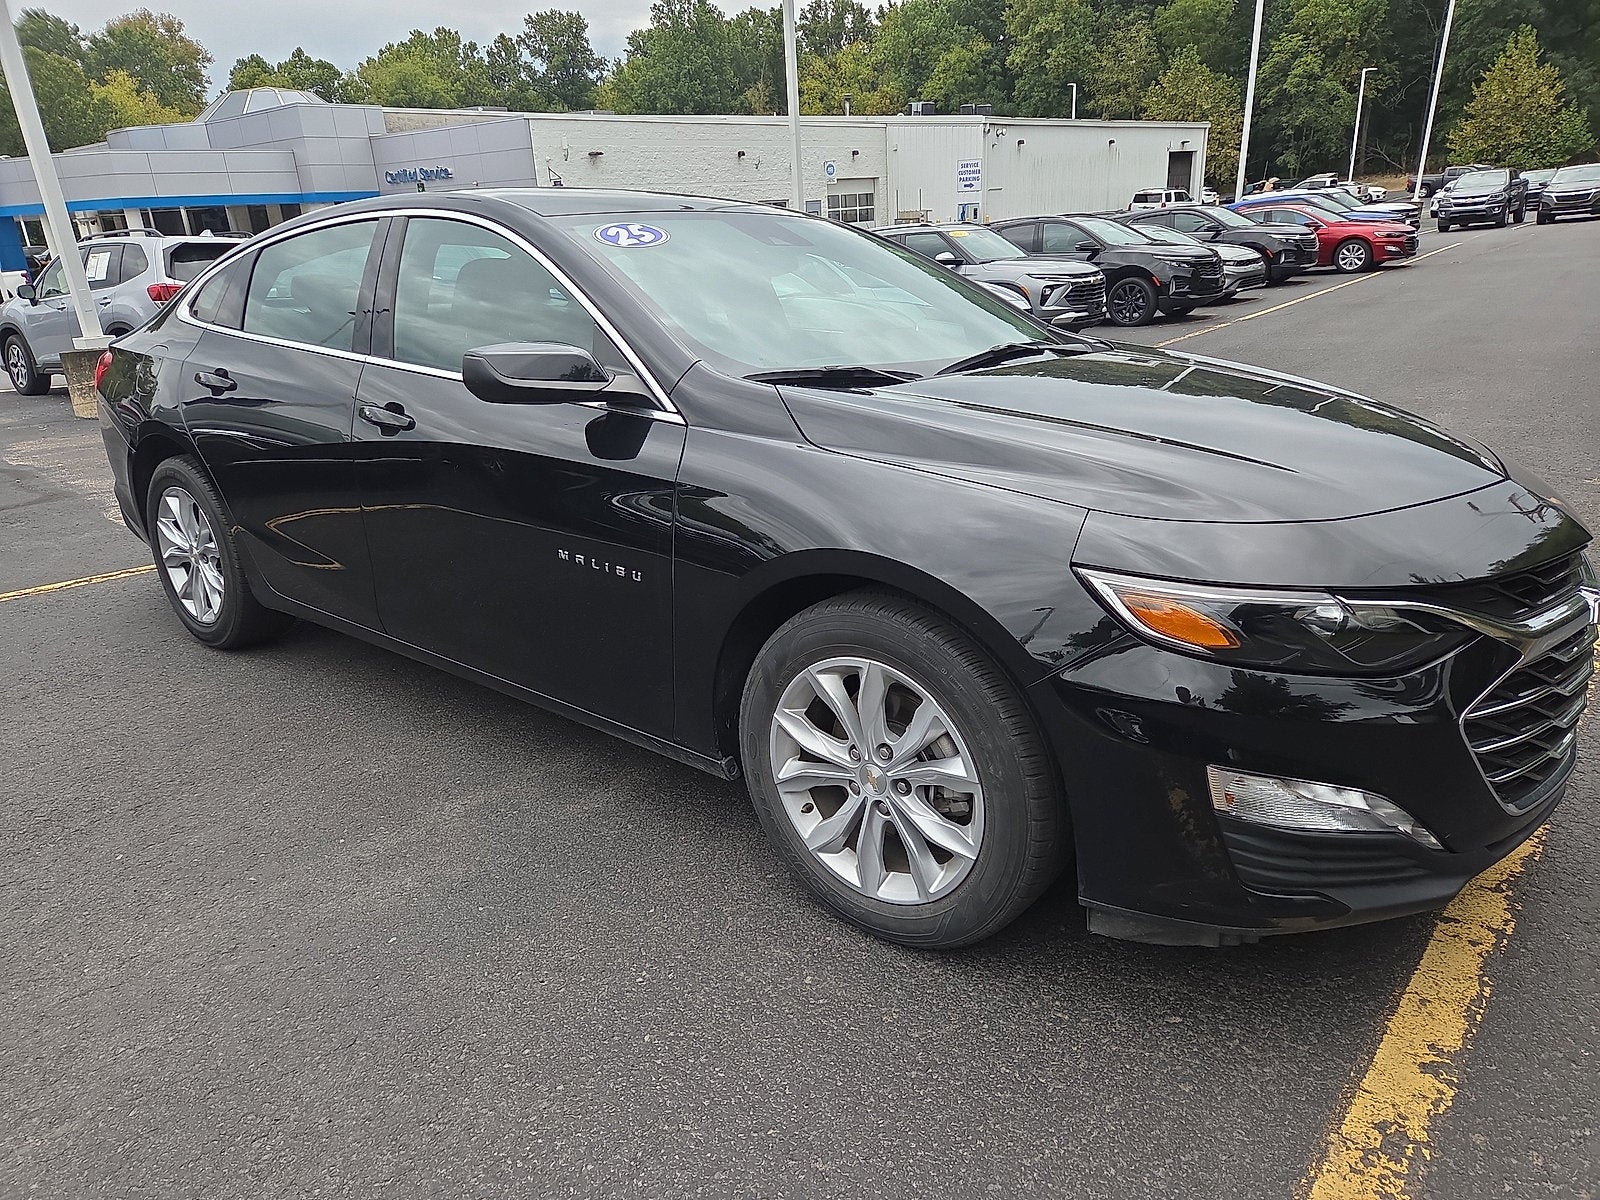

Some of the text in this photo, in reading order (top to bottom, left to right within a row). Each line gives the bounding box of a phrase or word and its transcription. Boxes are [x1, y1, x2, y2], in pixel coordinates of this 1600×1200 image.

[385, 165, 452, 184] Certified Service
[960, 161, 979, 169] SERVICE
[606, 224, 657, 246] 25
[558, 549, 642, 582] MALIBU
